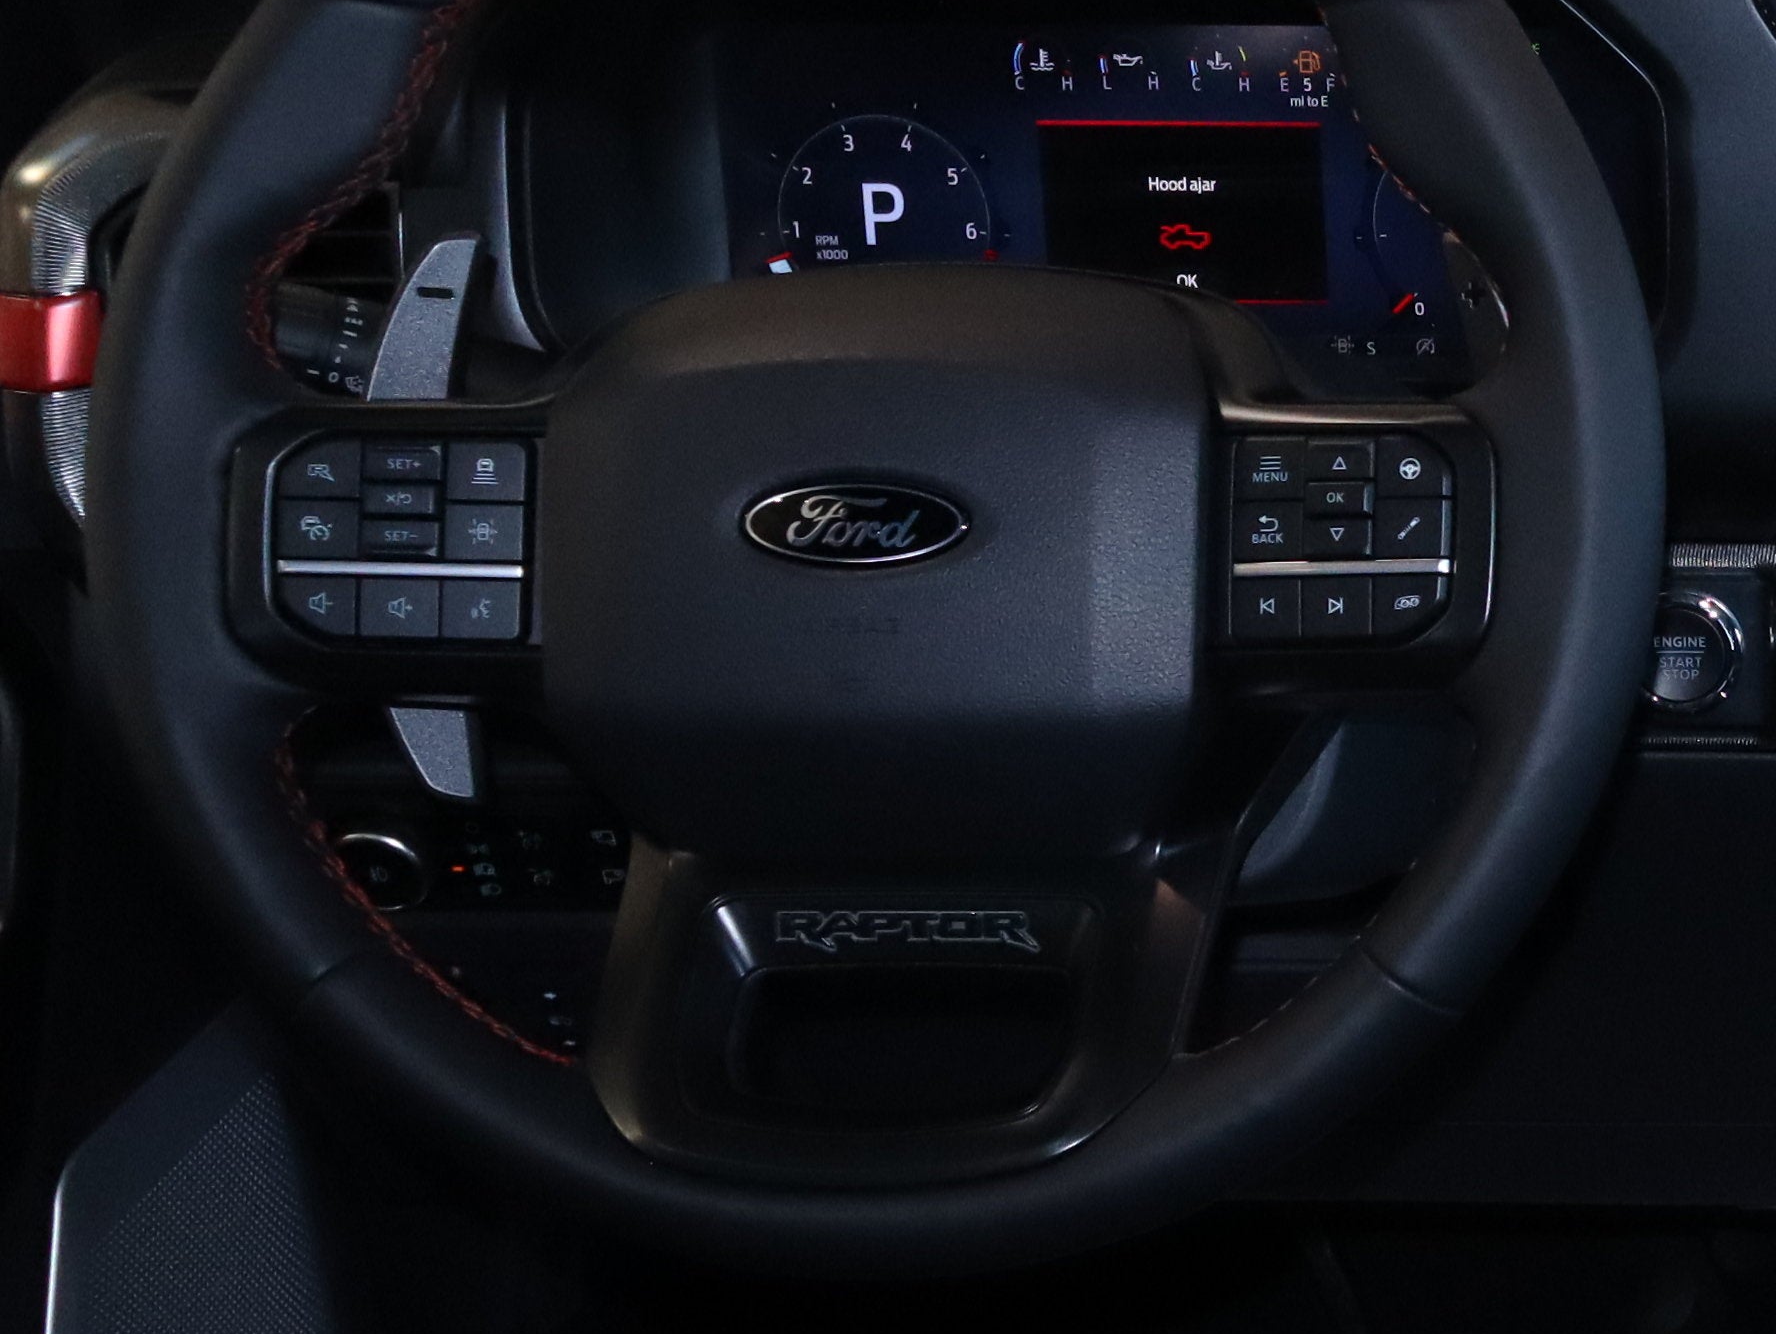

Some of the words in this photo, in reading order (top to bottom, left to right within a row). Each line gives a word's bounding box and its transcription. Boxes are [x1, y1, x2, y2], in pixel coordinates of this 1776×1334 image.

[1014, 76, 1025, 91] C
[1062, 75, 1073, 91] H
[1102, 75, 1113, 91] L
[1148, 75, 1160, 90] H
[1191, 76, 1202, 91] C
[1238, 76, 1250, 92] H
[1303, 78, 1312, 92] 5
[1307, 95, 1319, 107] to
[1321, 96, 1329, 107] E
[842, 134, 855, 152] 3
[900, 133, 913, 152] 4
[801, 167, 813, 185] 2
[946, 167, 959, 186] 5
[1147, 176, 1187, 192] Hood
[1189, 176, 1217, 195] ajar
[861, 182, 905, 246] P
[792, 220, 801, 238] 1
[965, 222, 978, 240] 6
[815, 235, 839, 247] RPM
[816, 249, 849, 260] x1000
[1176, 273, 1199, 289] OK
[386, 457, 422, 470] SET+
[1252, 471, 1289, 483] MENU
[1325, 491, 1345, 504] OK
[785, 494, 921, 548] Ford
[1251, 532, 1284, 544] BACK
[1653, 636, 1707, 648] ENGINE
[1659, 656, 1702, 668] START
[1662, 669, 1700, 681] STOP
[775, 910, 1040, 954] RAPTOR
